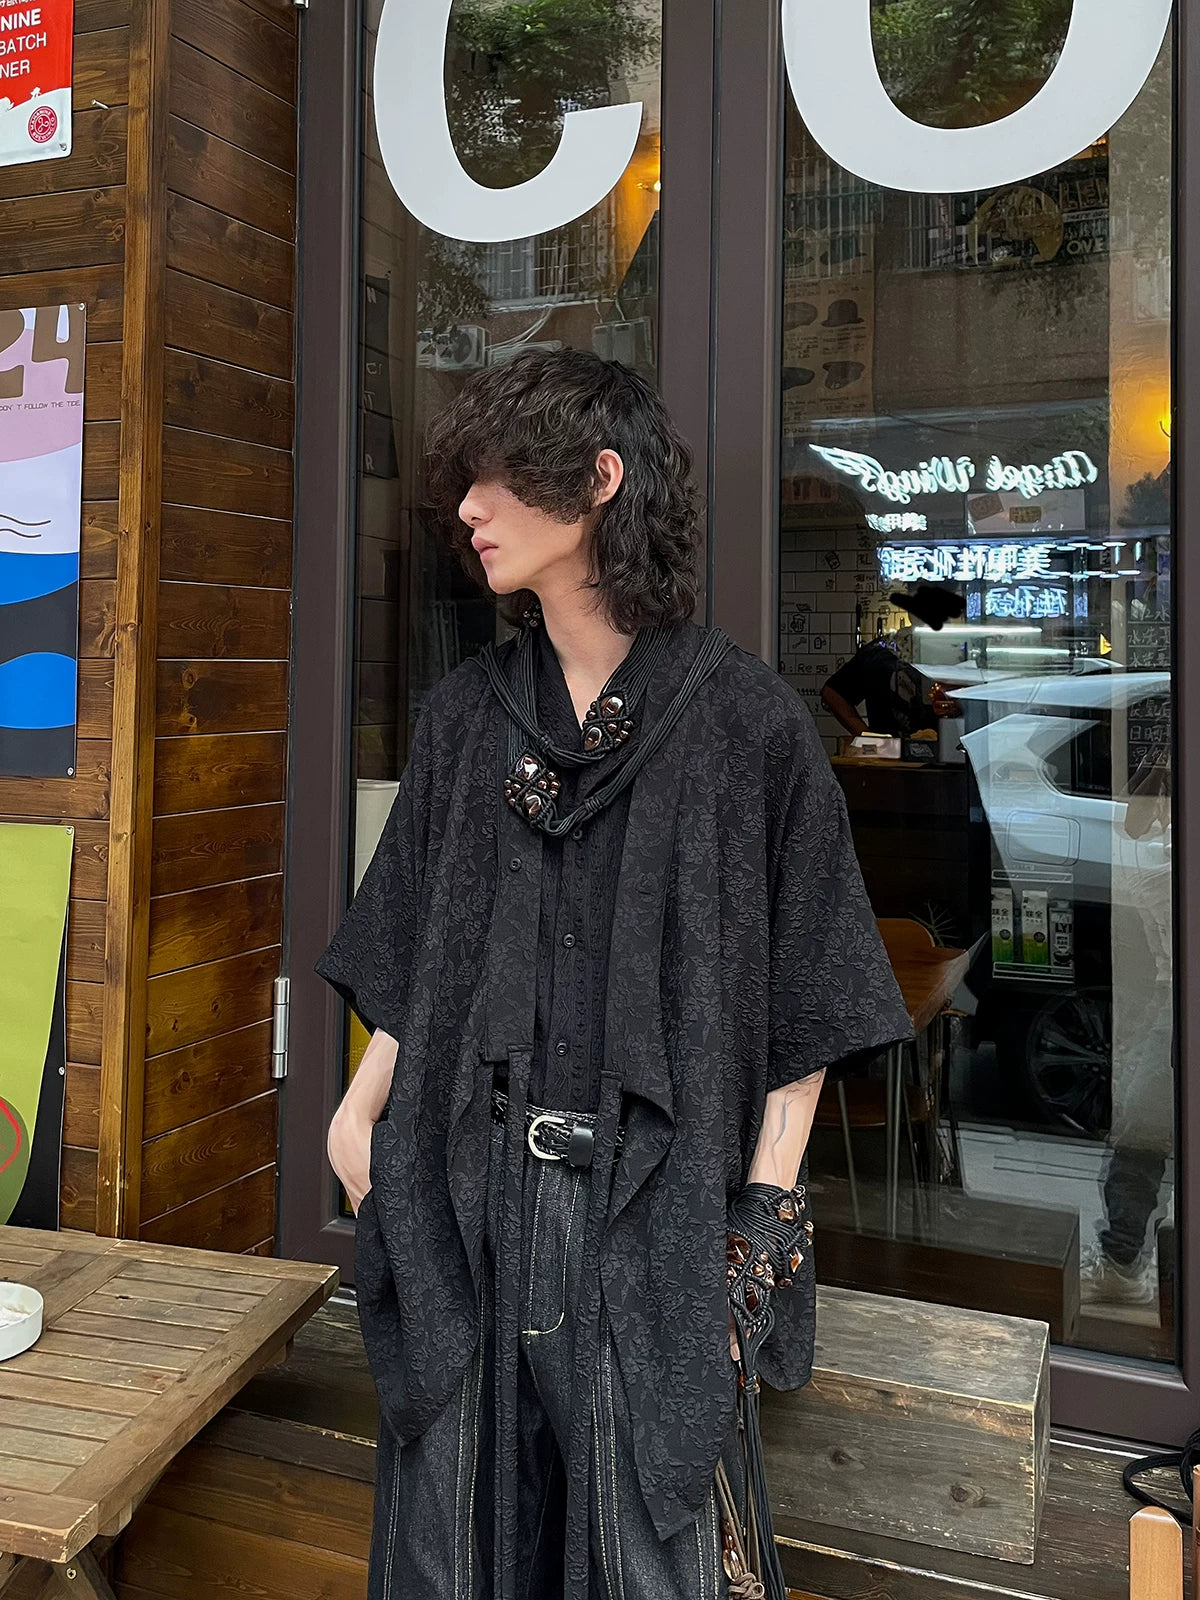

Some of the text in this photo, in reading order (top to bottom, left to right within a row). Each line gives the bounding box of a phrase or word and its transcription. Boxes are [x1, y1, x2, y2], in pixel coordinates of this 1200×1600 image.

[0, 32, 47, 56] BATCH
[24, 402, 48, 410] FOLLOW
[51, 400, 64, 408] THE
